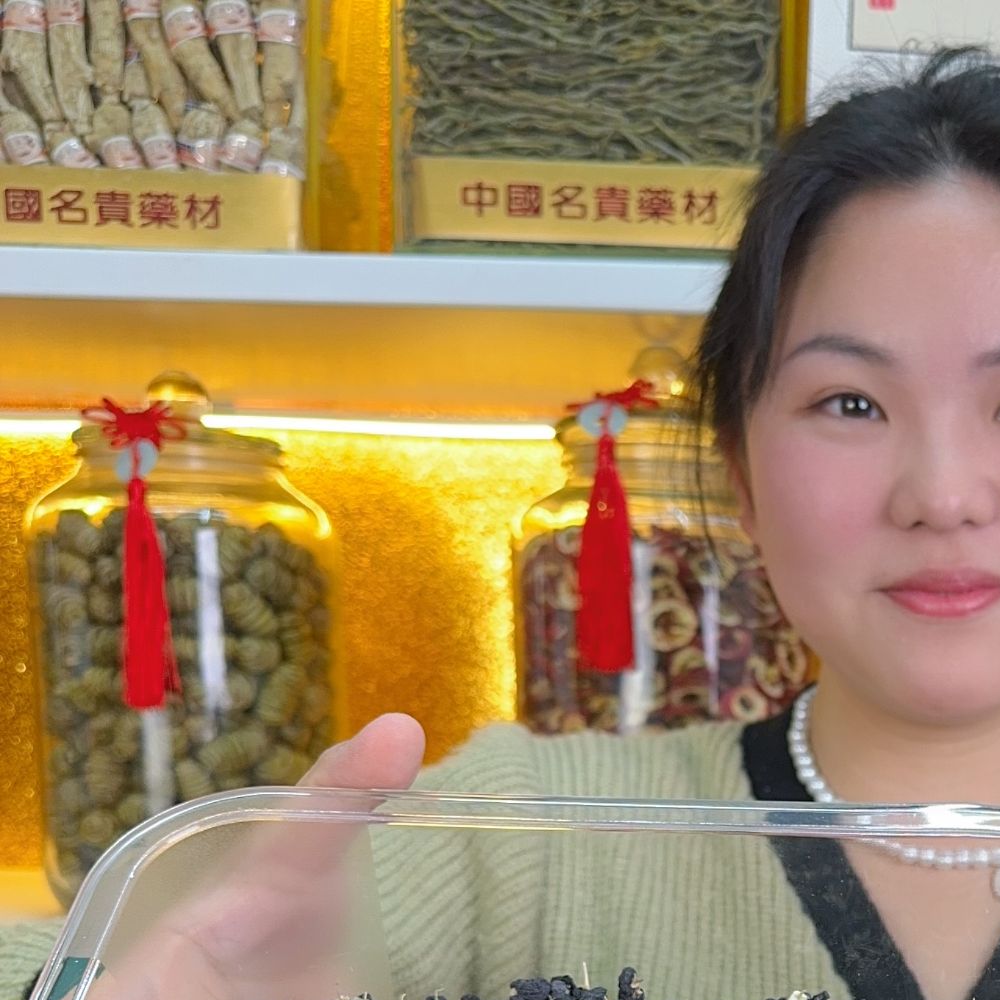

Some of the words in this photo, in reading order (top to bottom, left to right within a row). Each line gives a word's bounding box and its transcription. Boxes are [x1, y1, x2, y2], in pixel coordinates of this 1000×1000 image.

[4, 188, 223, 229] 國名貴藥材
[461, 182, 719, 225] 中國名貴藥材
